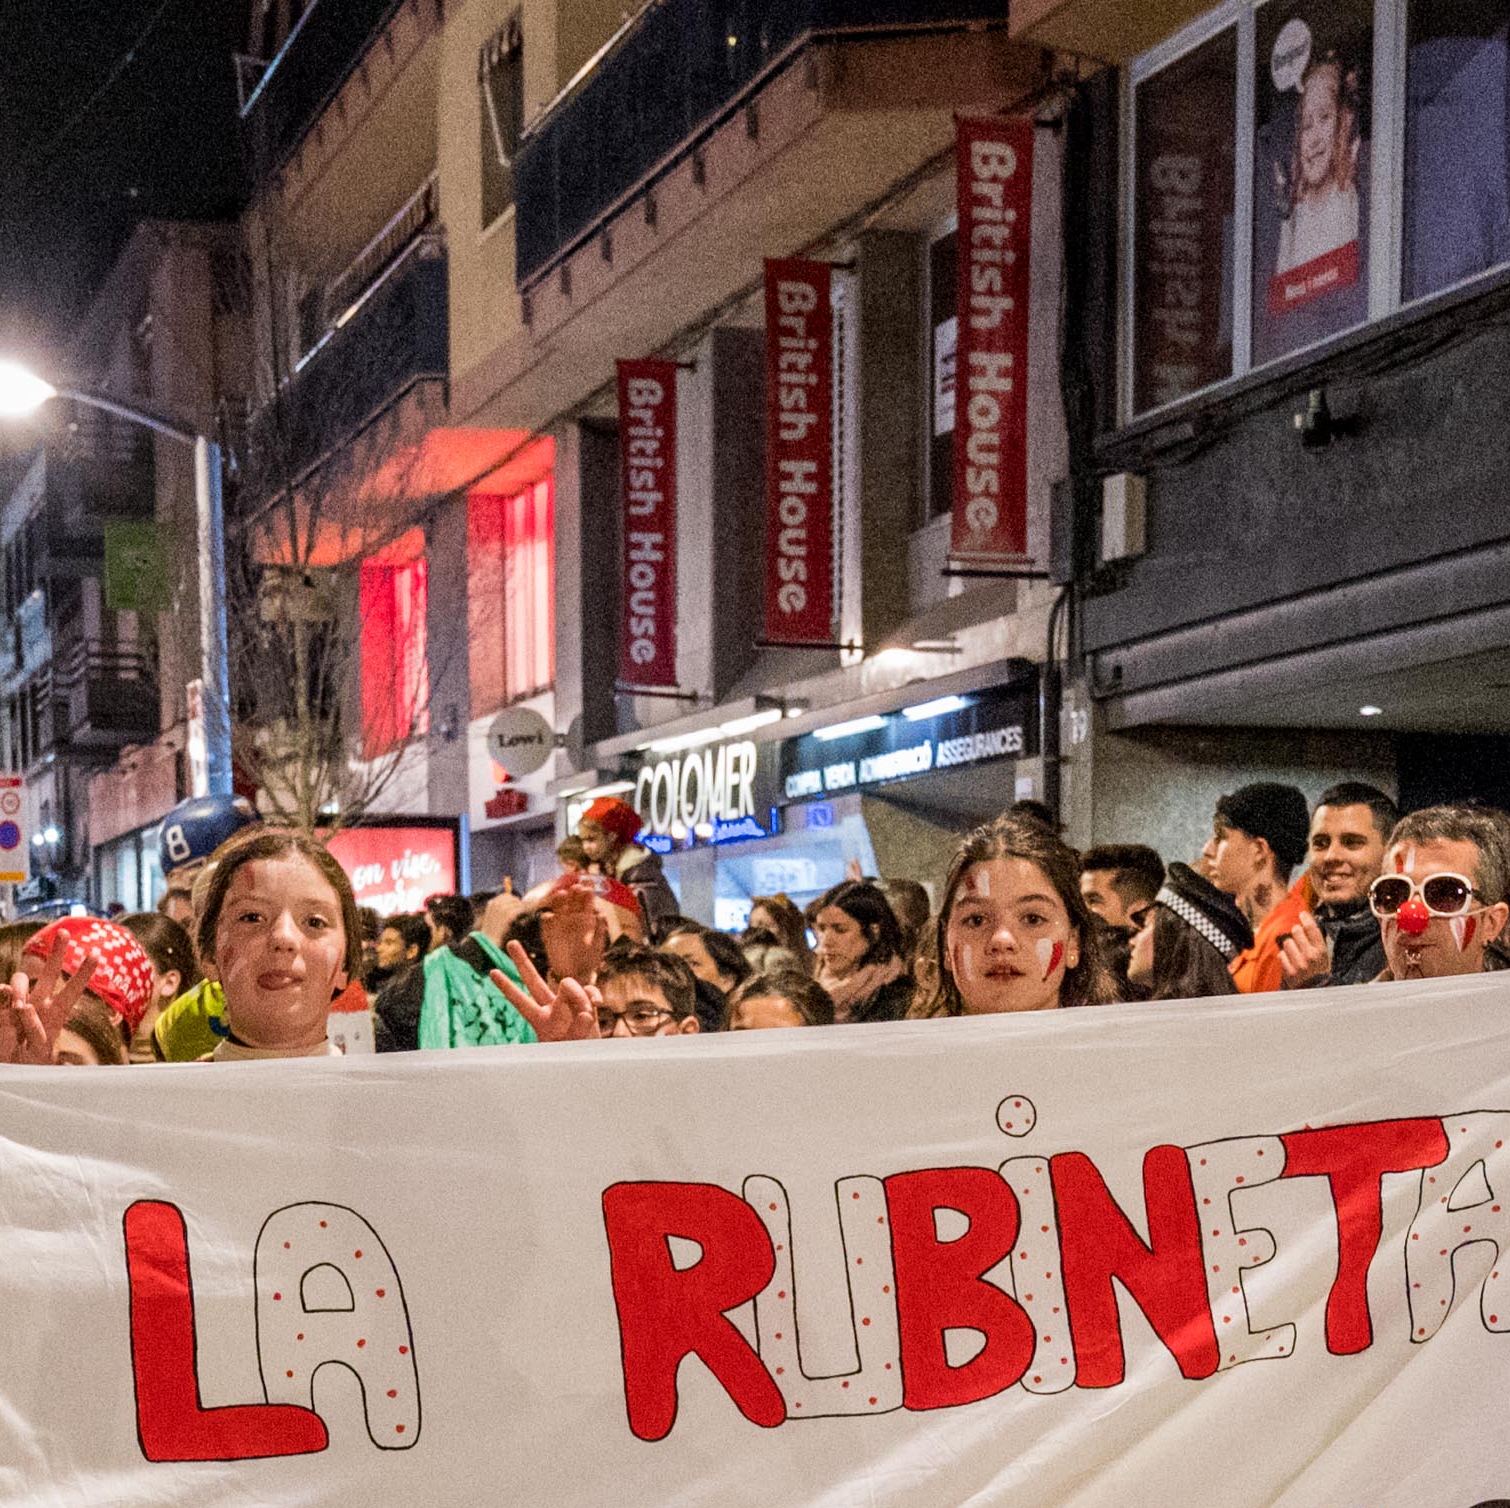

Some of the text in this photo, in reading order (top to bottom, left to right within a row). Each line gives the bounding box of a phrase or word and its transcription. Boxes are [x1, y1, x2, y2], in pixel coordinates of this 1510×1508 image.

[778, 280, 818, 614] British House
[965, 140, 1017, 530] British House
[628, 377, 664, 664] British House
[497, 729, 544, 748] Lowi
[634, 741, 758, 835] COLOMER
[823, 760, 857, 790] VENDA
[936, 726, 1023, 768] ASSEGURANCES
[122, 1198, 421, 1463] LA
